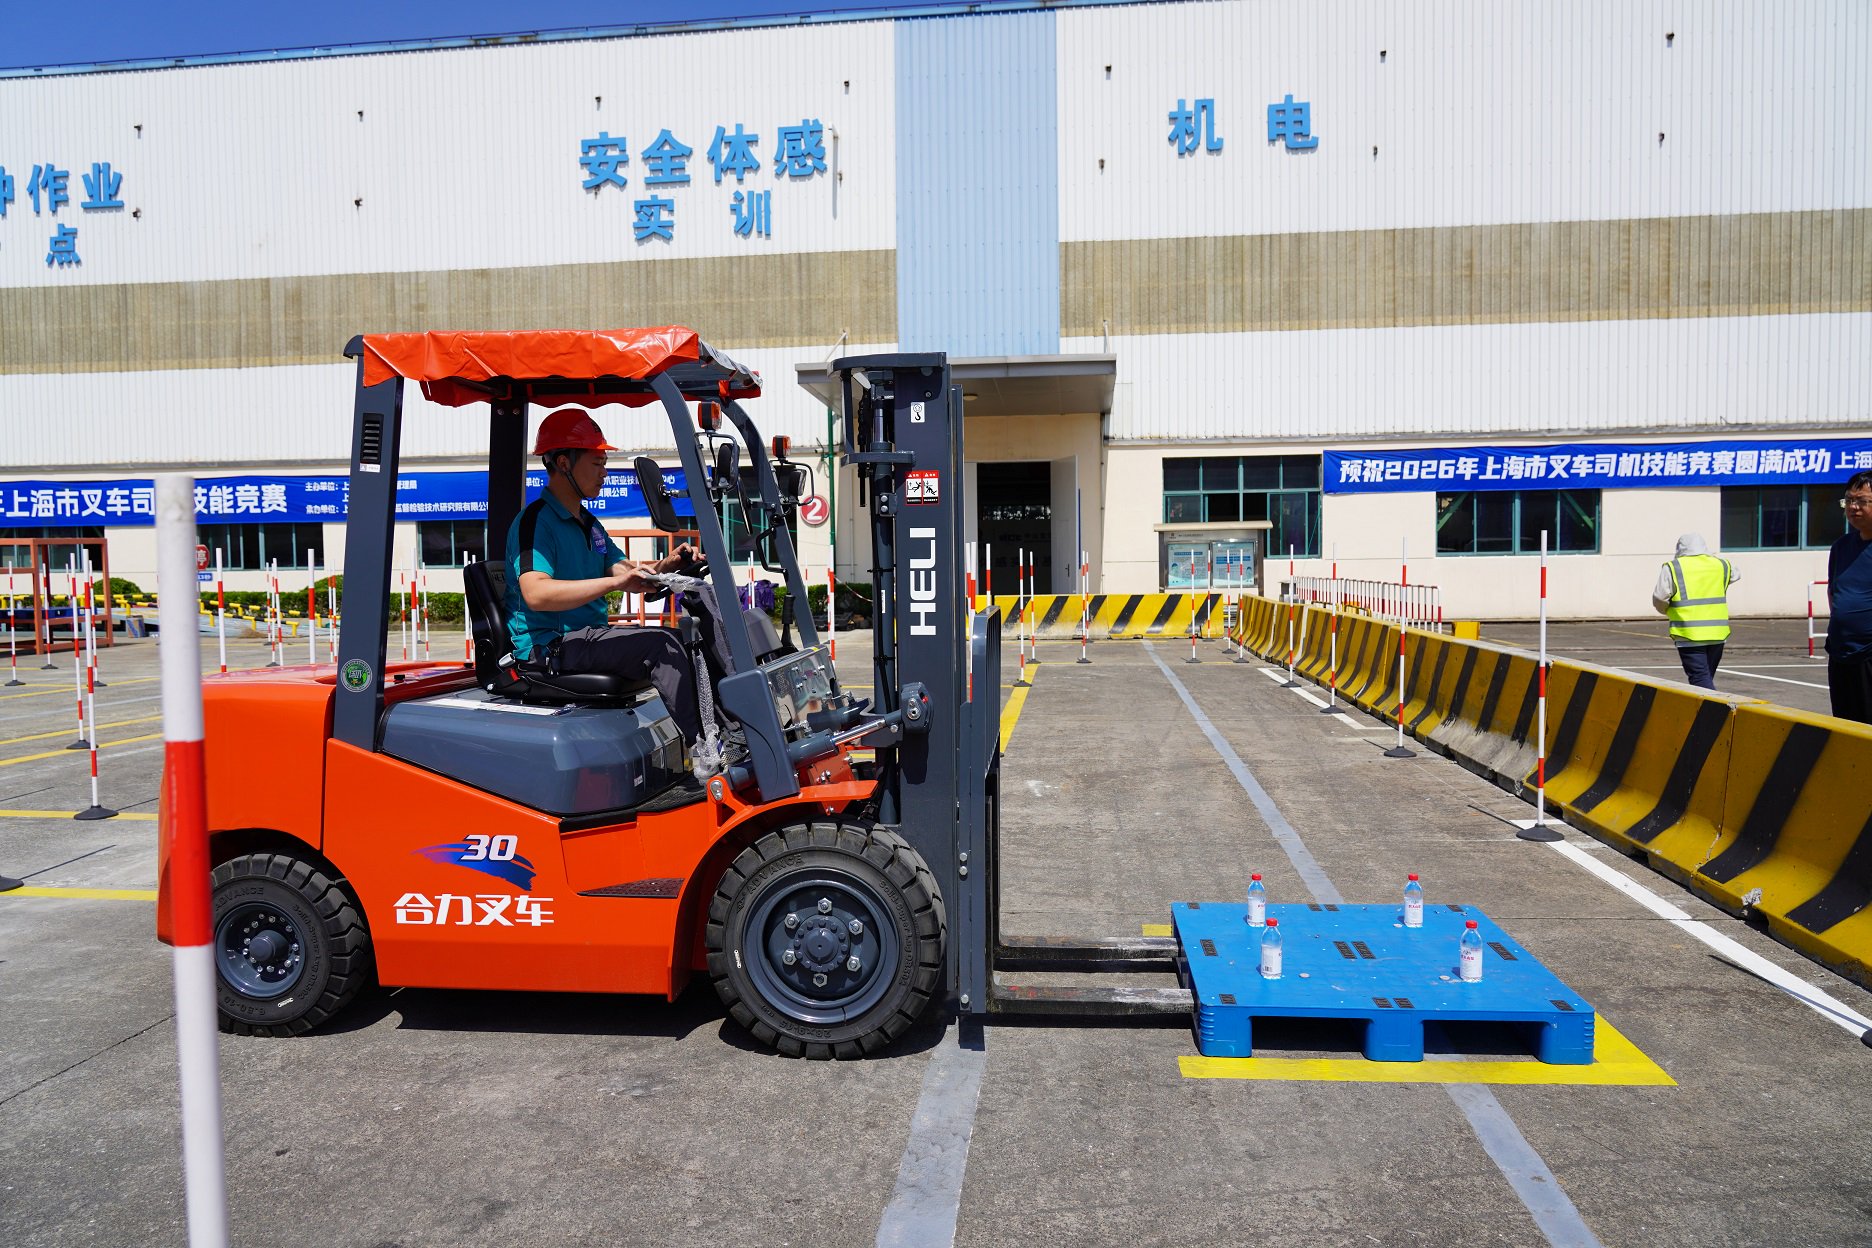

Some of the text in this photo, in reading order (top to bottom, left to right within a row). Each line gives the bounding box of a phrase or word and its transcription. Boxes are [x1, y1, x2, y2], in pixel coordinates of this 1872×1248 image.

[1168, 94, 1320, 155] 机电
[579, 118, 827, 190] 安全体感
[632, 190, 771, 240] 实训
[46, 223, 82, 266] 点
[1339, 448, 1831, 483] 预祝2026年上海市叉车司机技能竞赛圆满成功
[806, 498, 822, 521] 2
[909, 527, 937, 635] HELI
[459, 834, 518, 861] 30
[393, 892, 554, 927] 合力叉车
